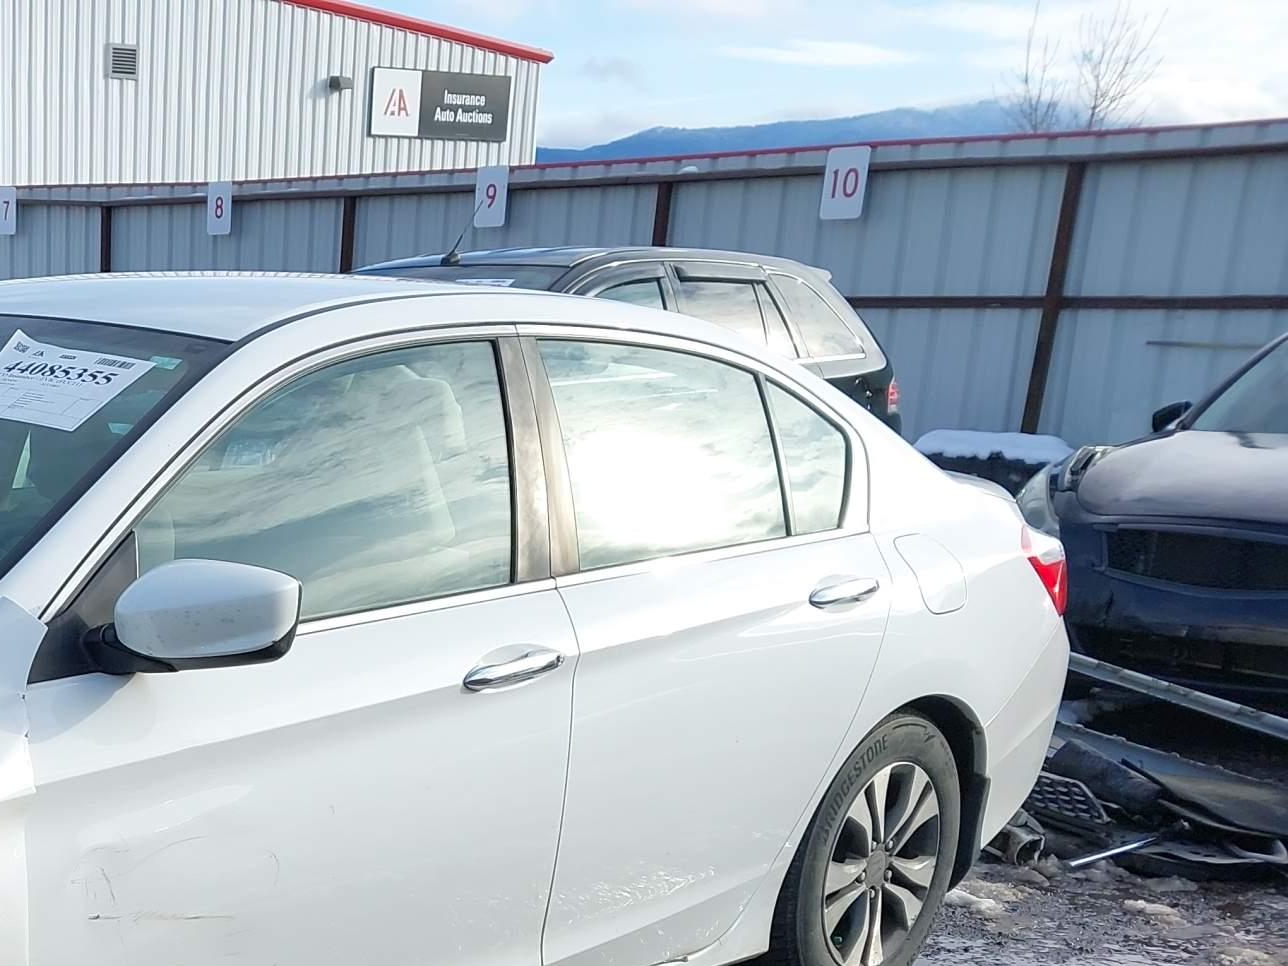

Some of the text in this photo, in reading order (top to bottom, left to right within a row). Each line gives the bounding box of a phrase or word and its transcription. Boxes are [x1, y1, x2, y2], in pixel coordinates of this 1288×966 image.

[444, 89, 486, 106] Insurance
[434, 107, 493, 124] Auto Auctions
[831, 167, 859, 199] 10
[214, 196, 224, 219] 8
[486, 183, 497, 209] 9
[2, 200, 11, 221] 7
[2, 360, 120, 386] 44085355
[820, 734, 889, 845] BRIDGESTONE
